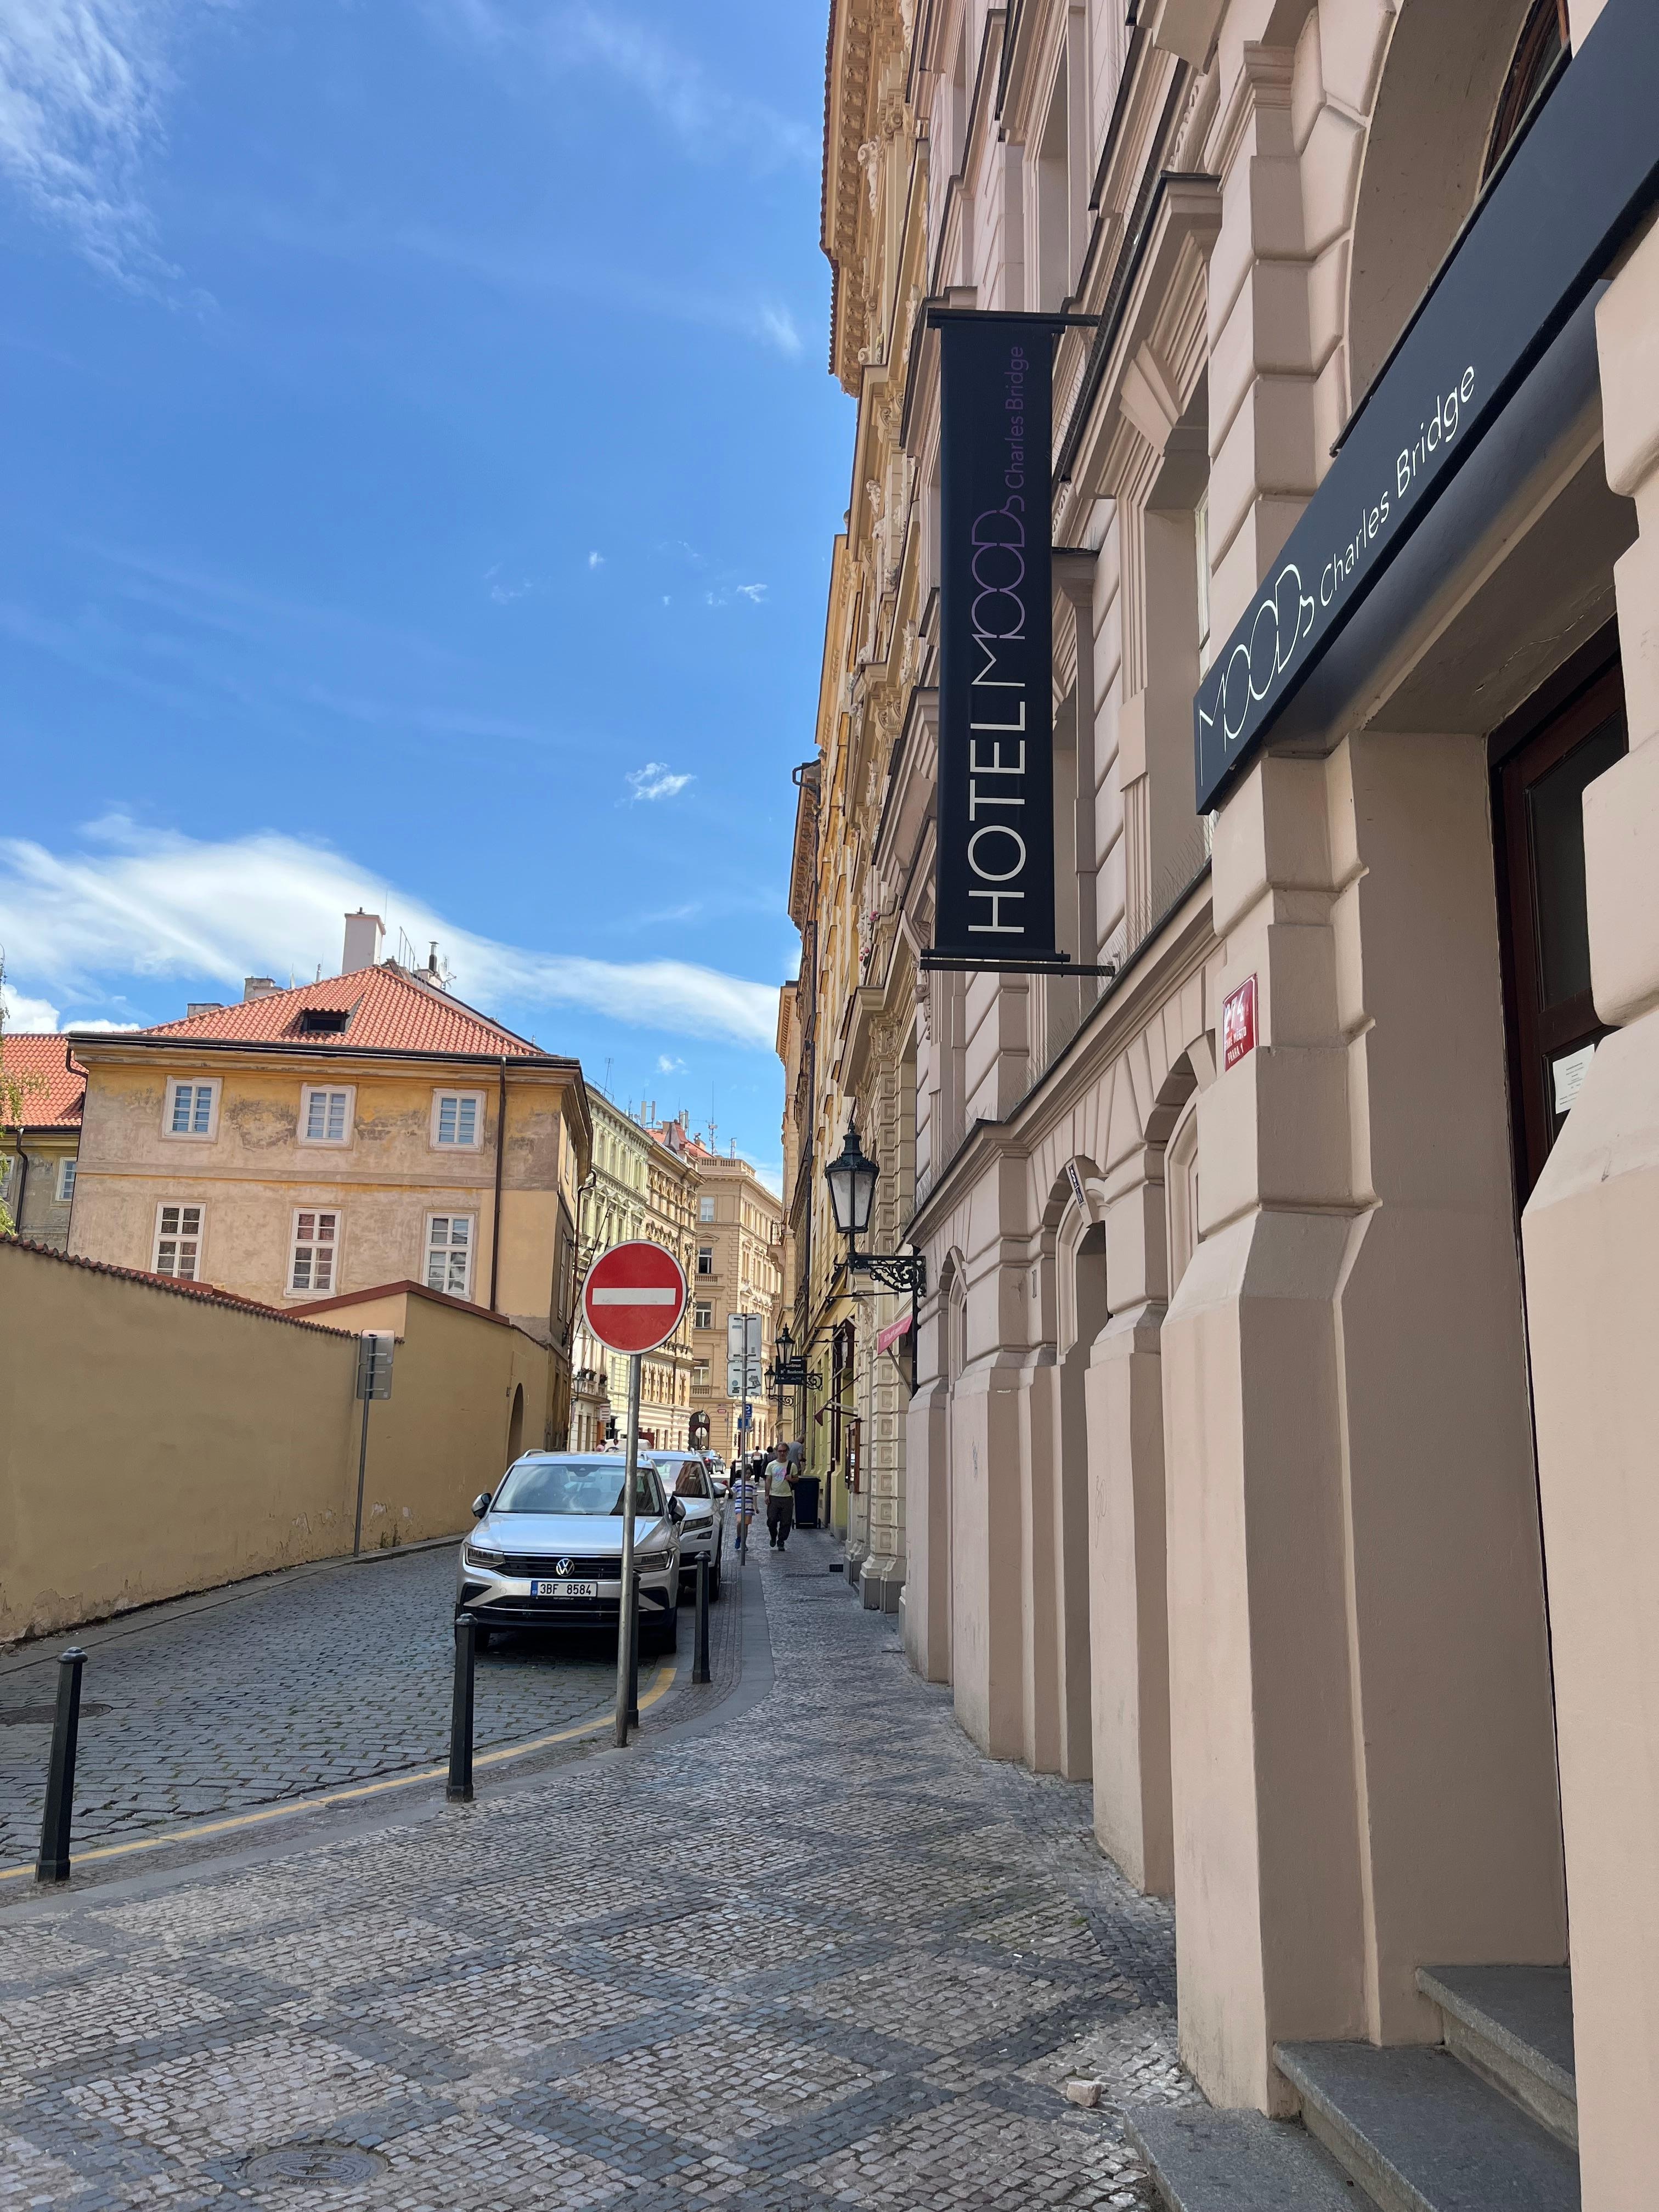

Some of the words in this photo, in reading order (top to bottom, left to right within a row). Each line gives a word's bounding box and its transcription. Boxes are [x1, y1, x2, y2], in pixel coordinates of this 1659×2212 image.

[1003, 346, 1029, 410] Bridge
[1004, 415, 1024, 489] Charles
[1320, 490, 1390, 607] Charles
[1397, 365, 1475, 499] Bridge
[967, 701, 1026, 934] HOTEL
[540, 1583, 558, 1594] 3BF
[567, 1584, 591, 1595] 8584
